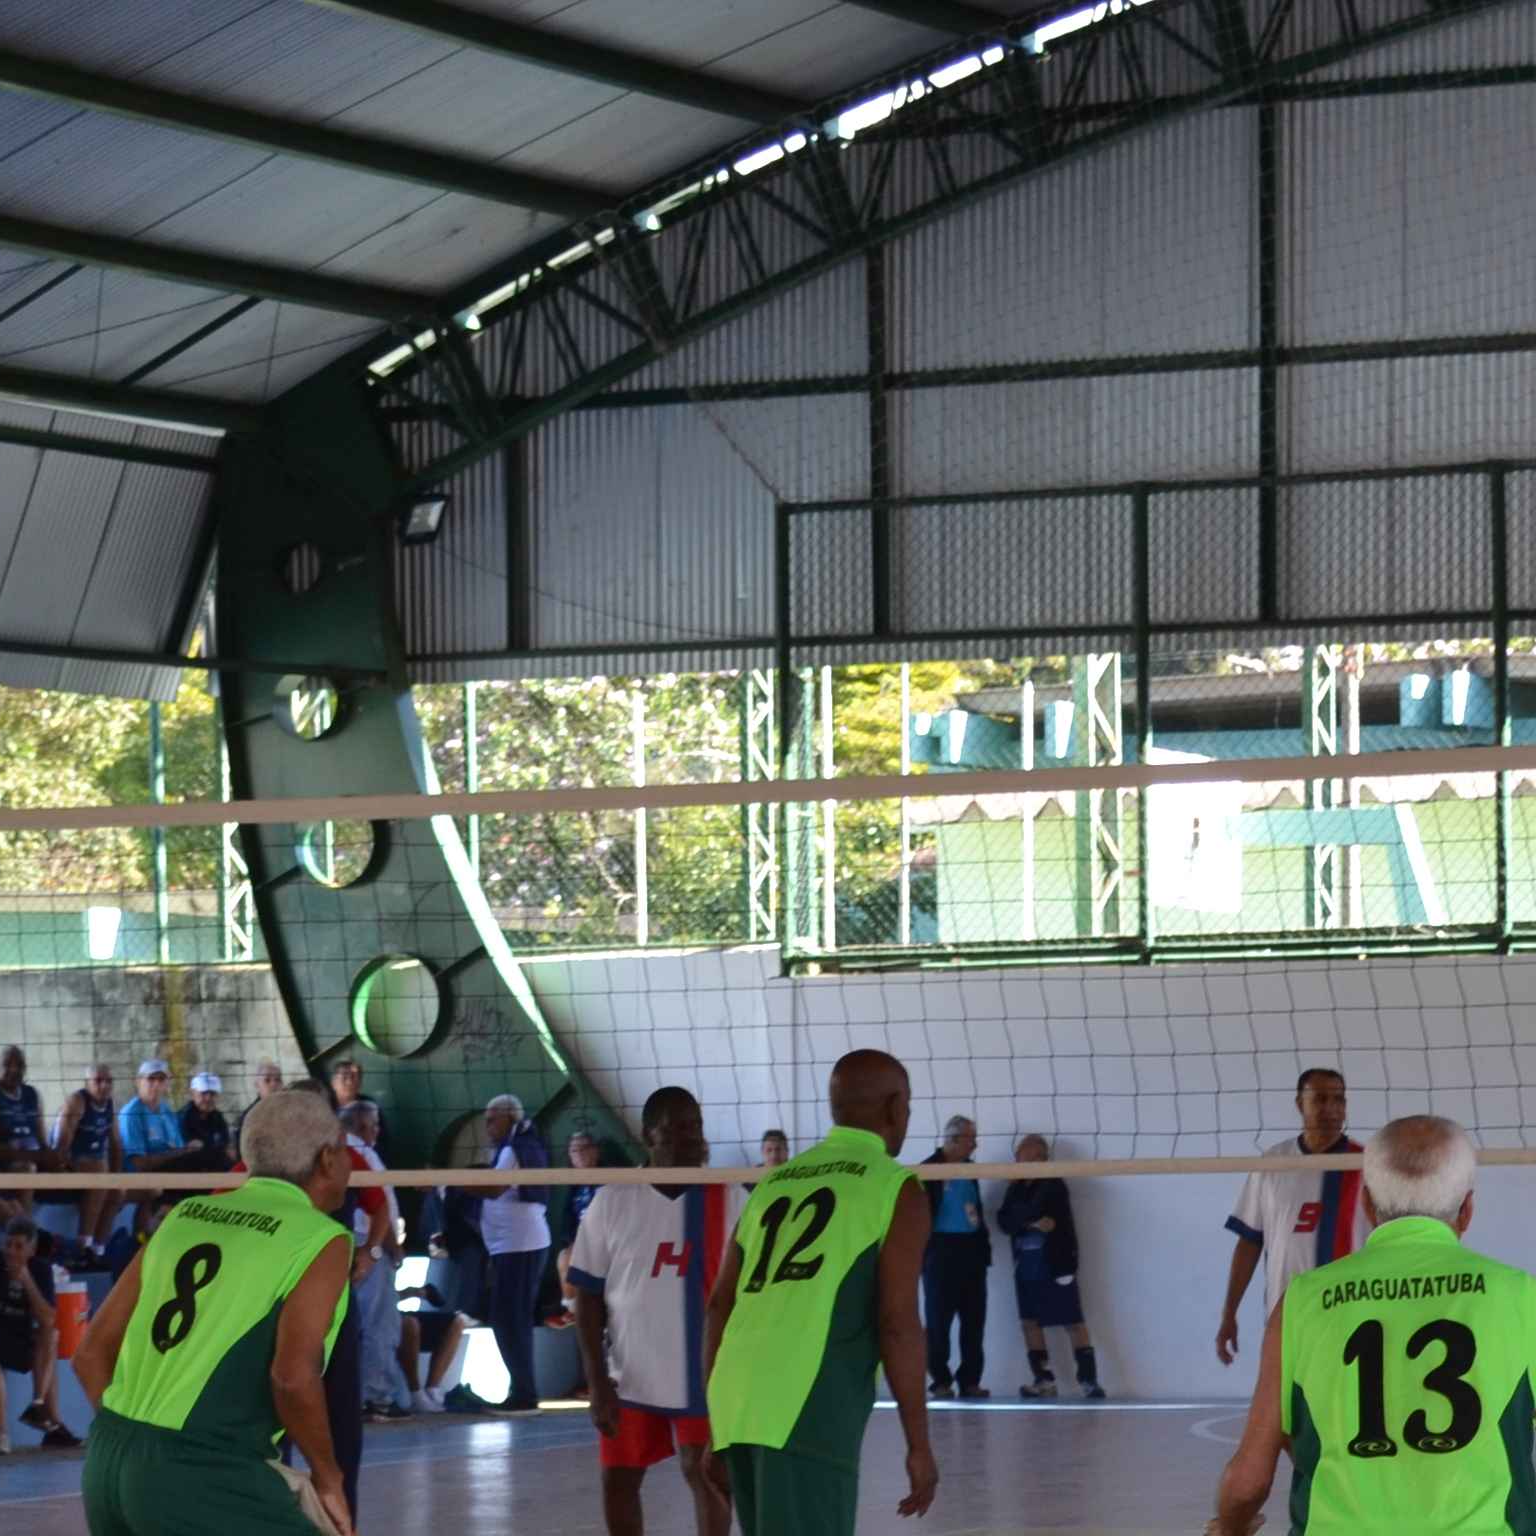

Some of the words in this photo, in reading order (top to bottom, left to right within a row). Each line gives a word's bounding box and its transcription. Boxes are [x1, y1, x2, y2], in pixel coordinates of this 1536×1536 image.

[178, 1201, 282, 1237] CARAGUATATUBA
[743, 1187, 836, 1293] 12
[1293, 1203, 1324, 1233] 9
[152, 1243, 222, 1354] 8
[1322, 1273, 1486, 1310] CARAGUATATUBA
[1343, 1319, 1482, 1458] 13
